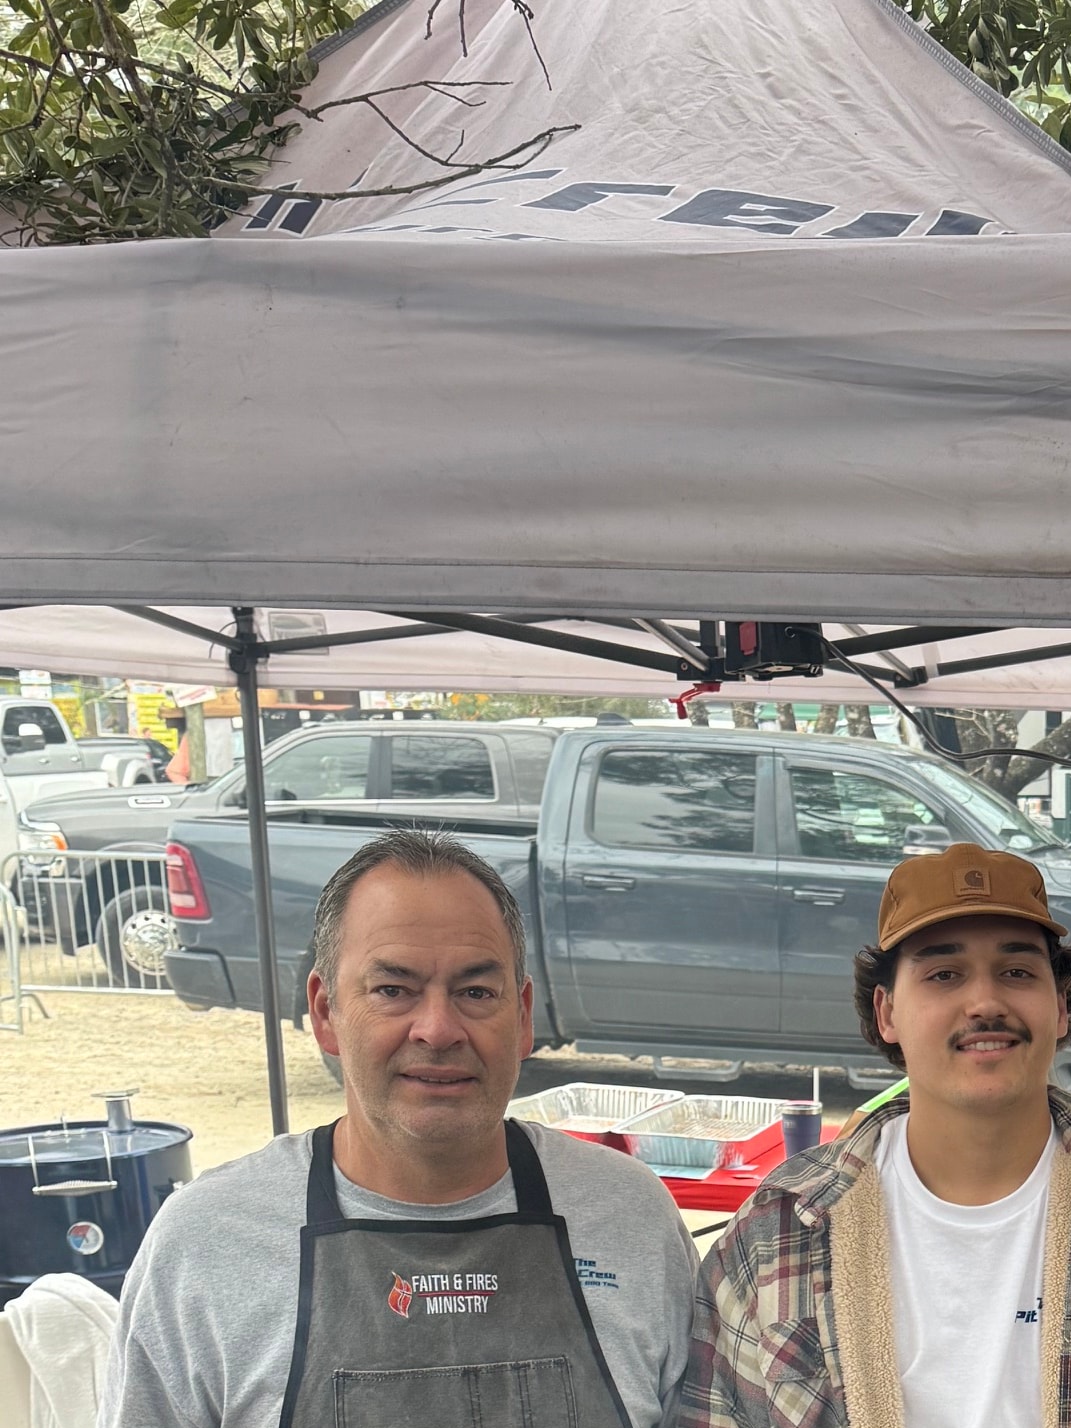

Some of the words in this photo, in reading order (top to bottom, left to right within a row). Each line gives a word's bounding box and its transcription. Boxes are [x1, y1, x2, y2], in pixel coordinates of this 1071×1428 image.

[412, 1273, 450, 1292] FAITH
[453, 1274, 463, 1291] &
[465, 1273, 499, 1291] FIRES
[577, 1269, 617, 1280] Crew
[426, 1295, 489, 1316] MINISTRY
[1014, 1310, 1038, 1324] Pit
